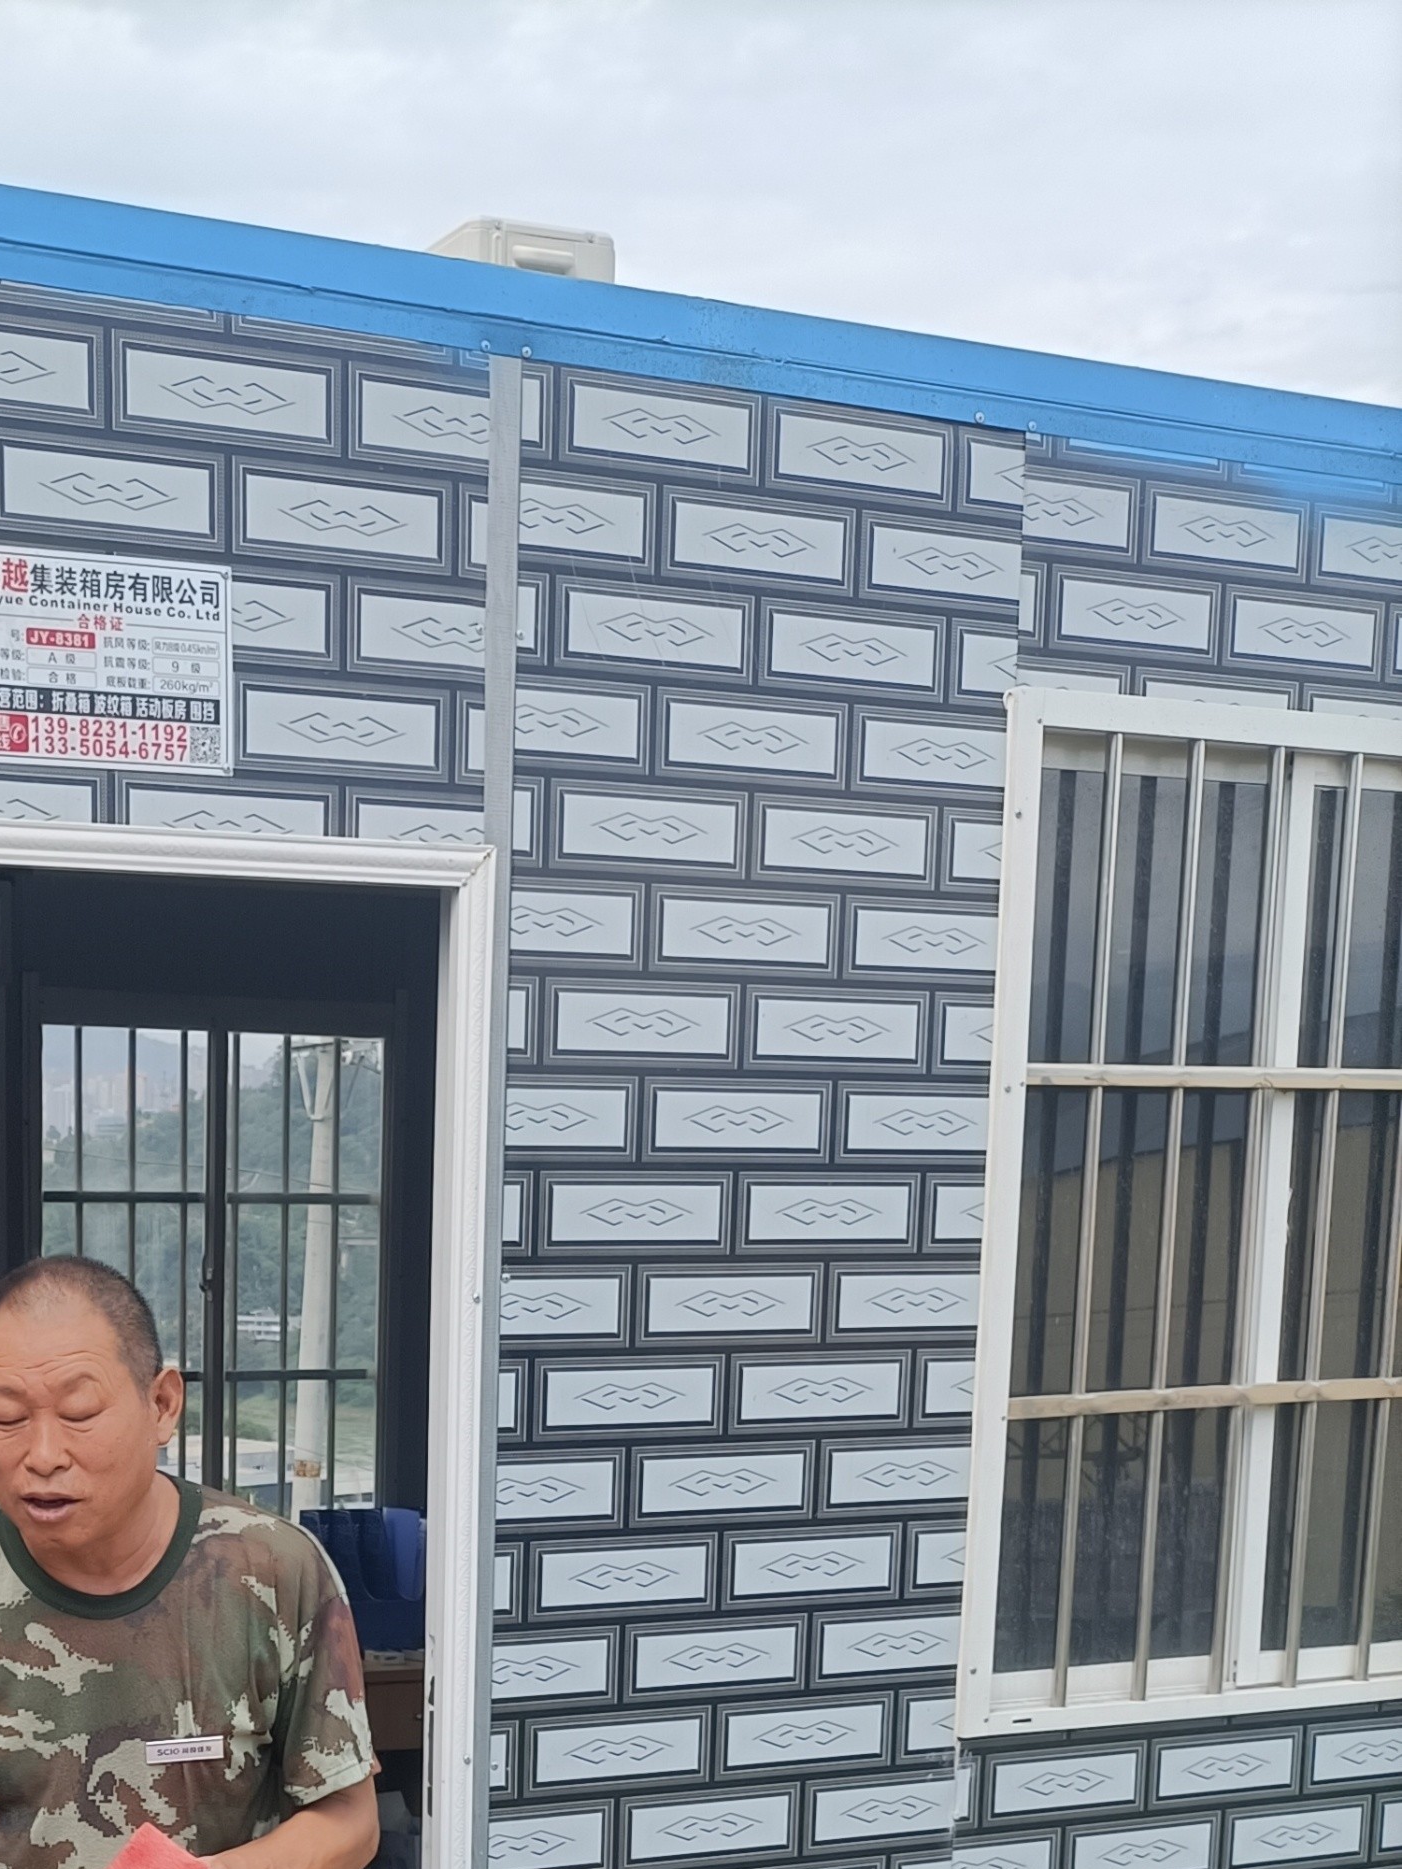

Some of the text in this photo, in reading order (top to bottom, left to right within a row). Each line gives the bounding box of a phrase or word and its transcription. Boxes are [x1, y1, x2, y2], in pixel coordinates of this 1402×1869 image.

[29, 596, 109, 613] Container
[113, 602, 162, 616] House
[167, 607, 191, 619] Co.
[196, 609, 220, 621] Ltd
[77, 613, 124, 632] 合格证
[30, 630, 90, 647] JY-8381
[135, 697, 187, 721] 活动板房
[31, 716, 188, 742] 139-8231-1192
[31, 736, 188, 762] 133-5054-6757
